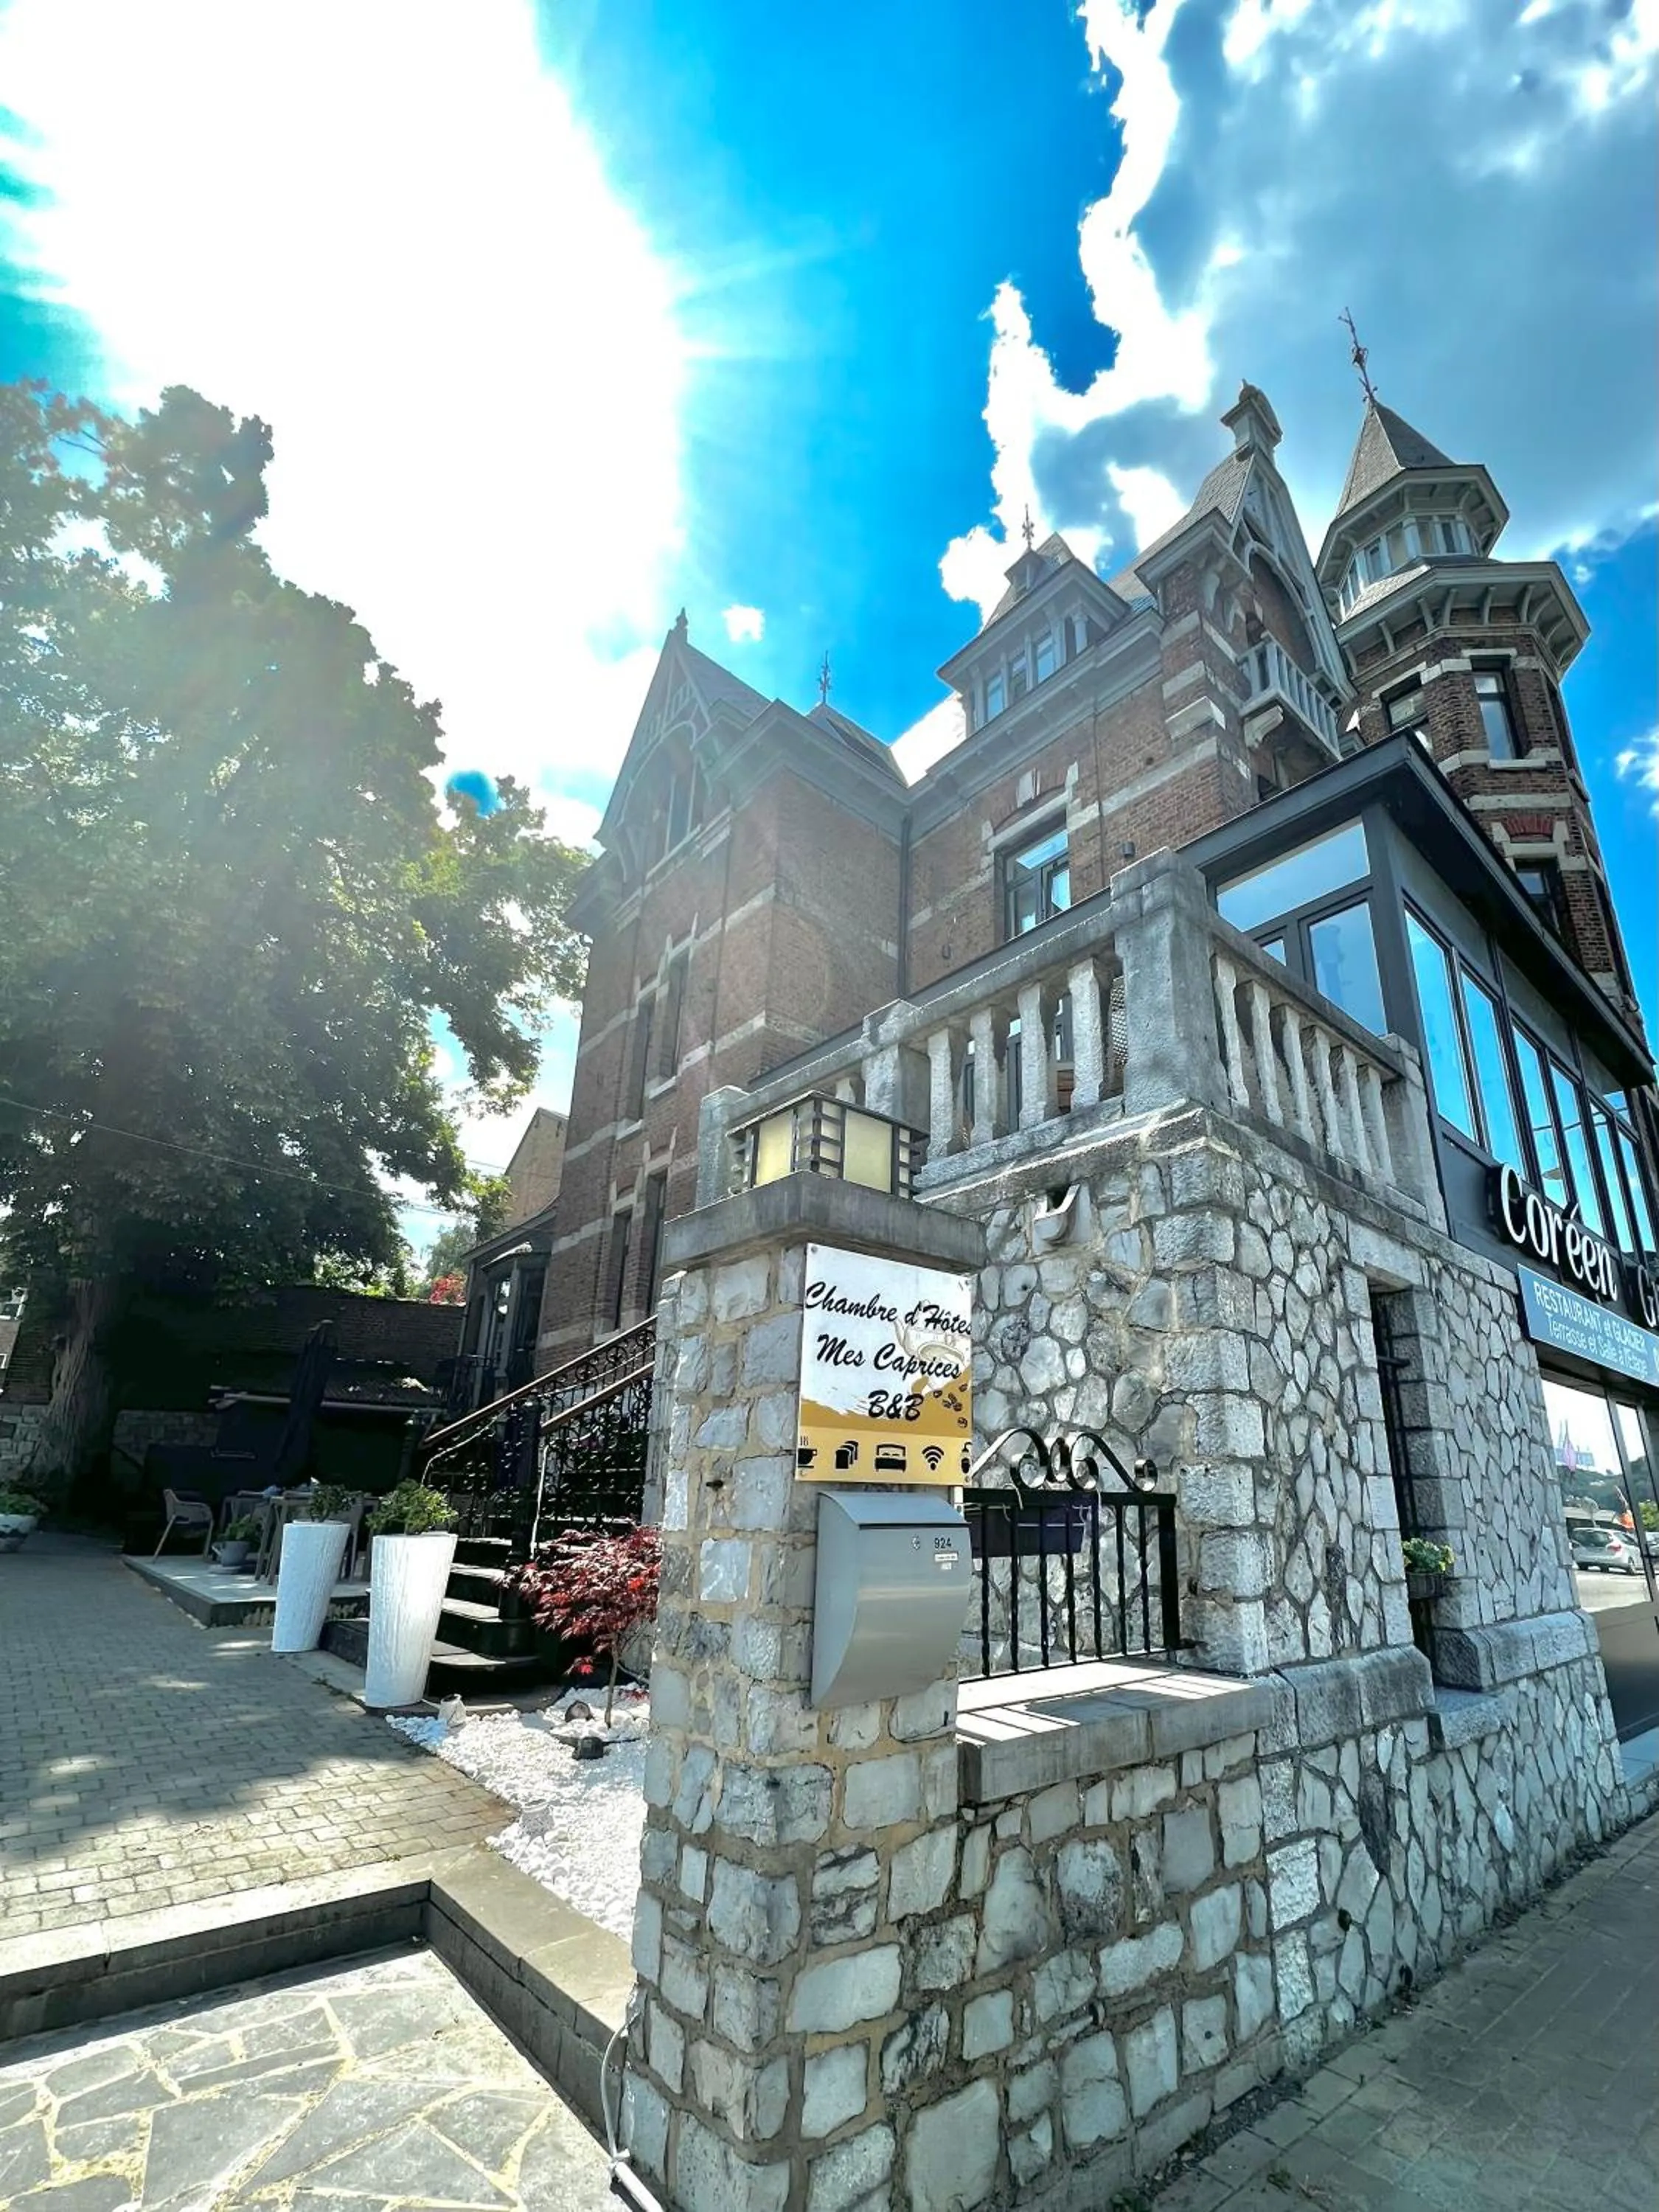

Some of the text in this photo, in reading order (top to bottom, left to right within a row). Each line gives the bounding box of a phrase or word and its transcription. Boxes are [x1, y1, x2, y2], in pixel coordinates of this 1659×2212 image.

[1500, 1164, 1617, 1301] Coréen
[805, 1281, 897, 1322] Chambre
[1534, 1281, 1602, 1333] RESTAURANT
[816, 1334, 961, 1381] Mes Caprices
[867, 1389, 924, 1422] B&B
[934, 1537, 952, 1549] 924
